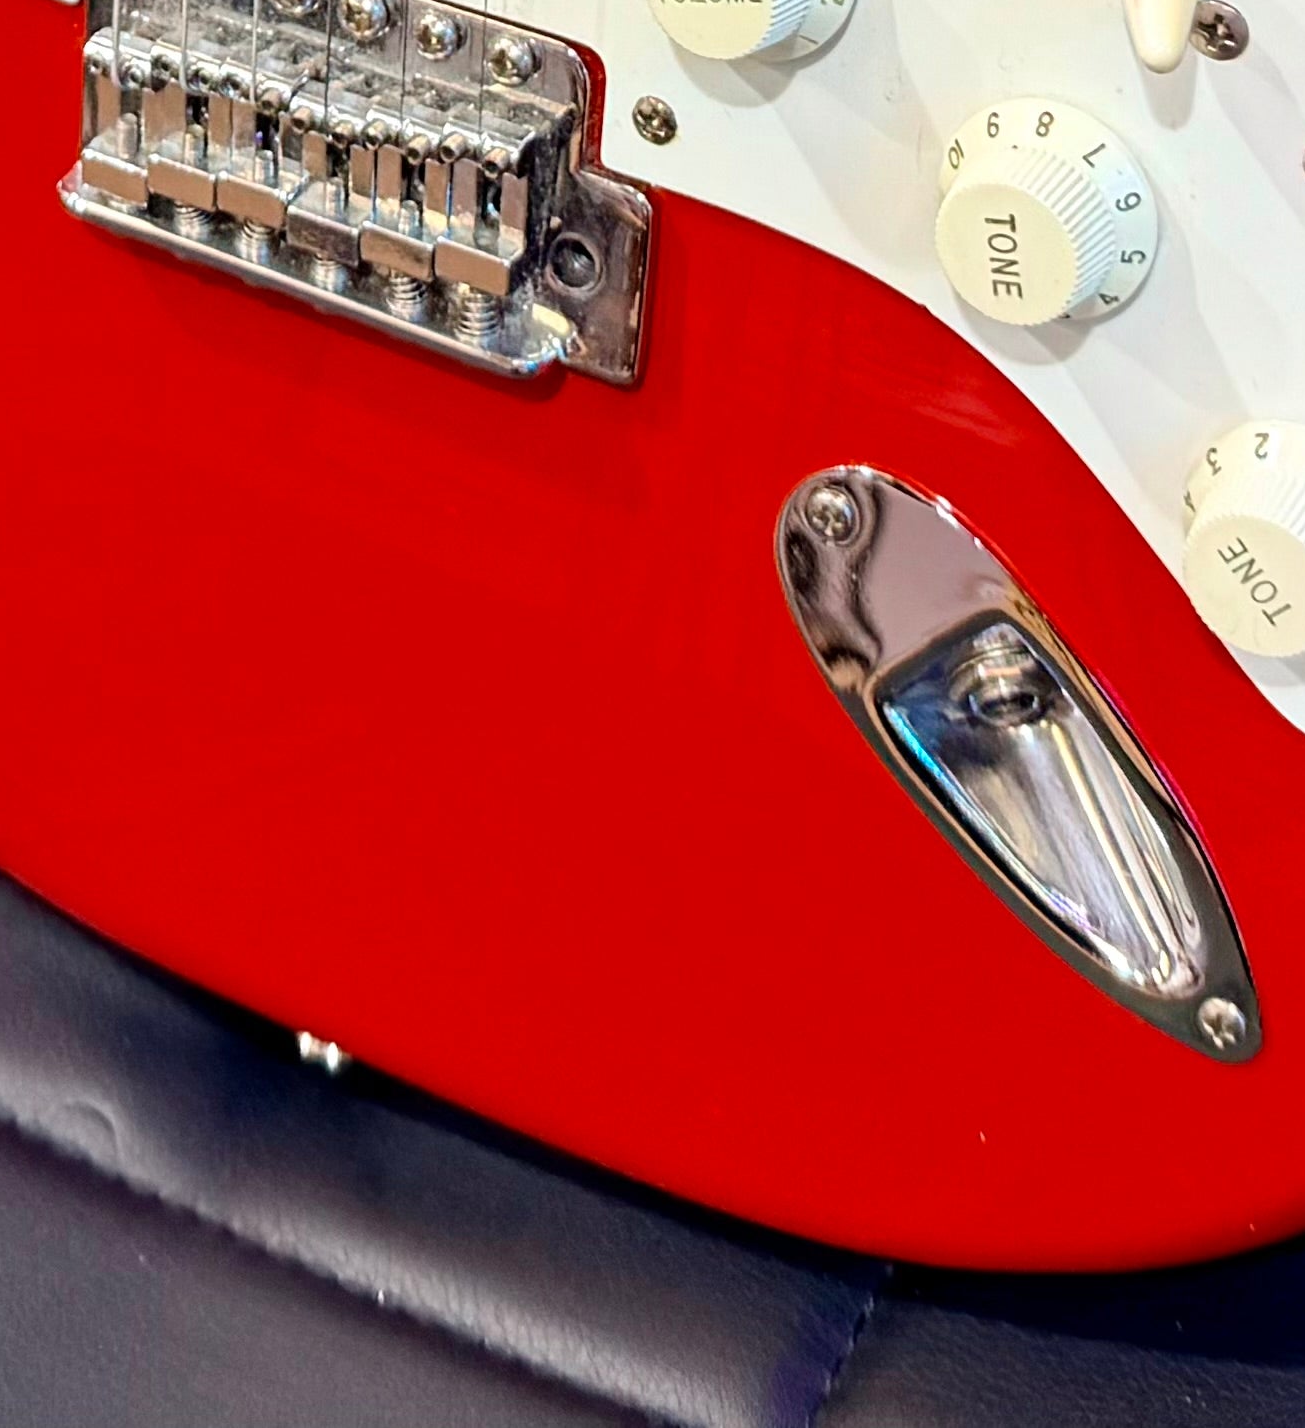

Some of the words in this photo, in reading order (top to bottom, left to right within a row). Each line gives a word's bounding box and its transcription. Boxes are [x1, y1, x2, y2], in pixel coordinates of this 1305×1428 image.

[1035, 110, 1055, 138] 8
[947, 138, 965, 170] 10
[1081, 142, 1106, 169] 7
[984, 213, 1024, 300] TONE
[1120, 249, 1147, 265] 5
[1097, 291, 1120, 307] 4
[1254, 432, 1269, 460] 2
[1205, 447, 1222, 476] 3
[1216, 536, 1292, 627] TONE
